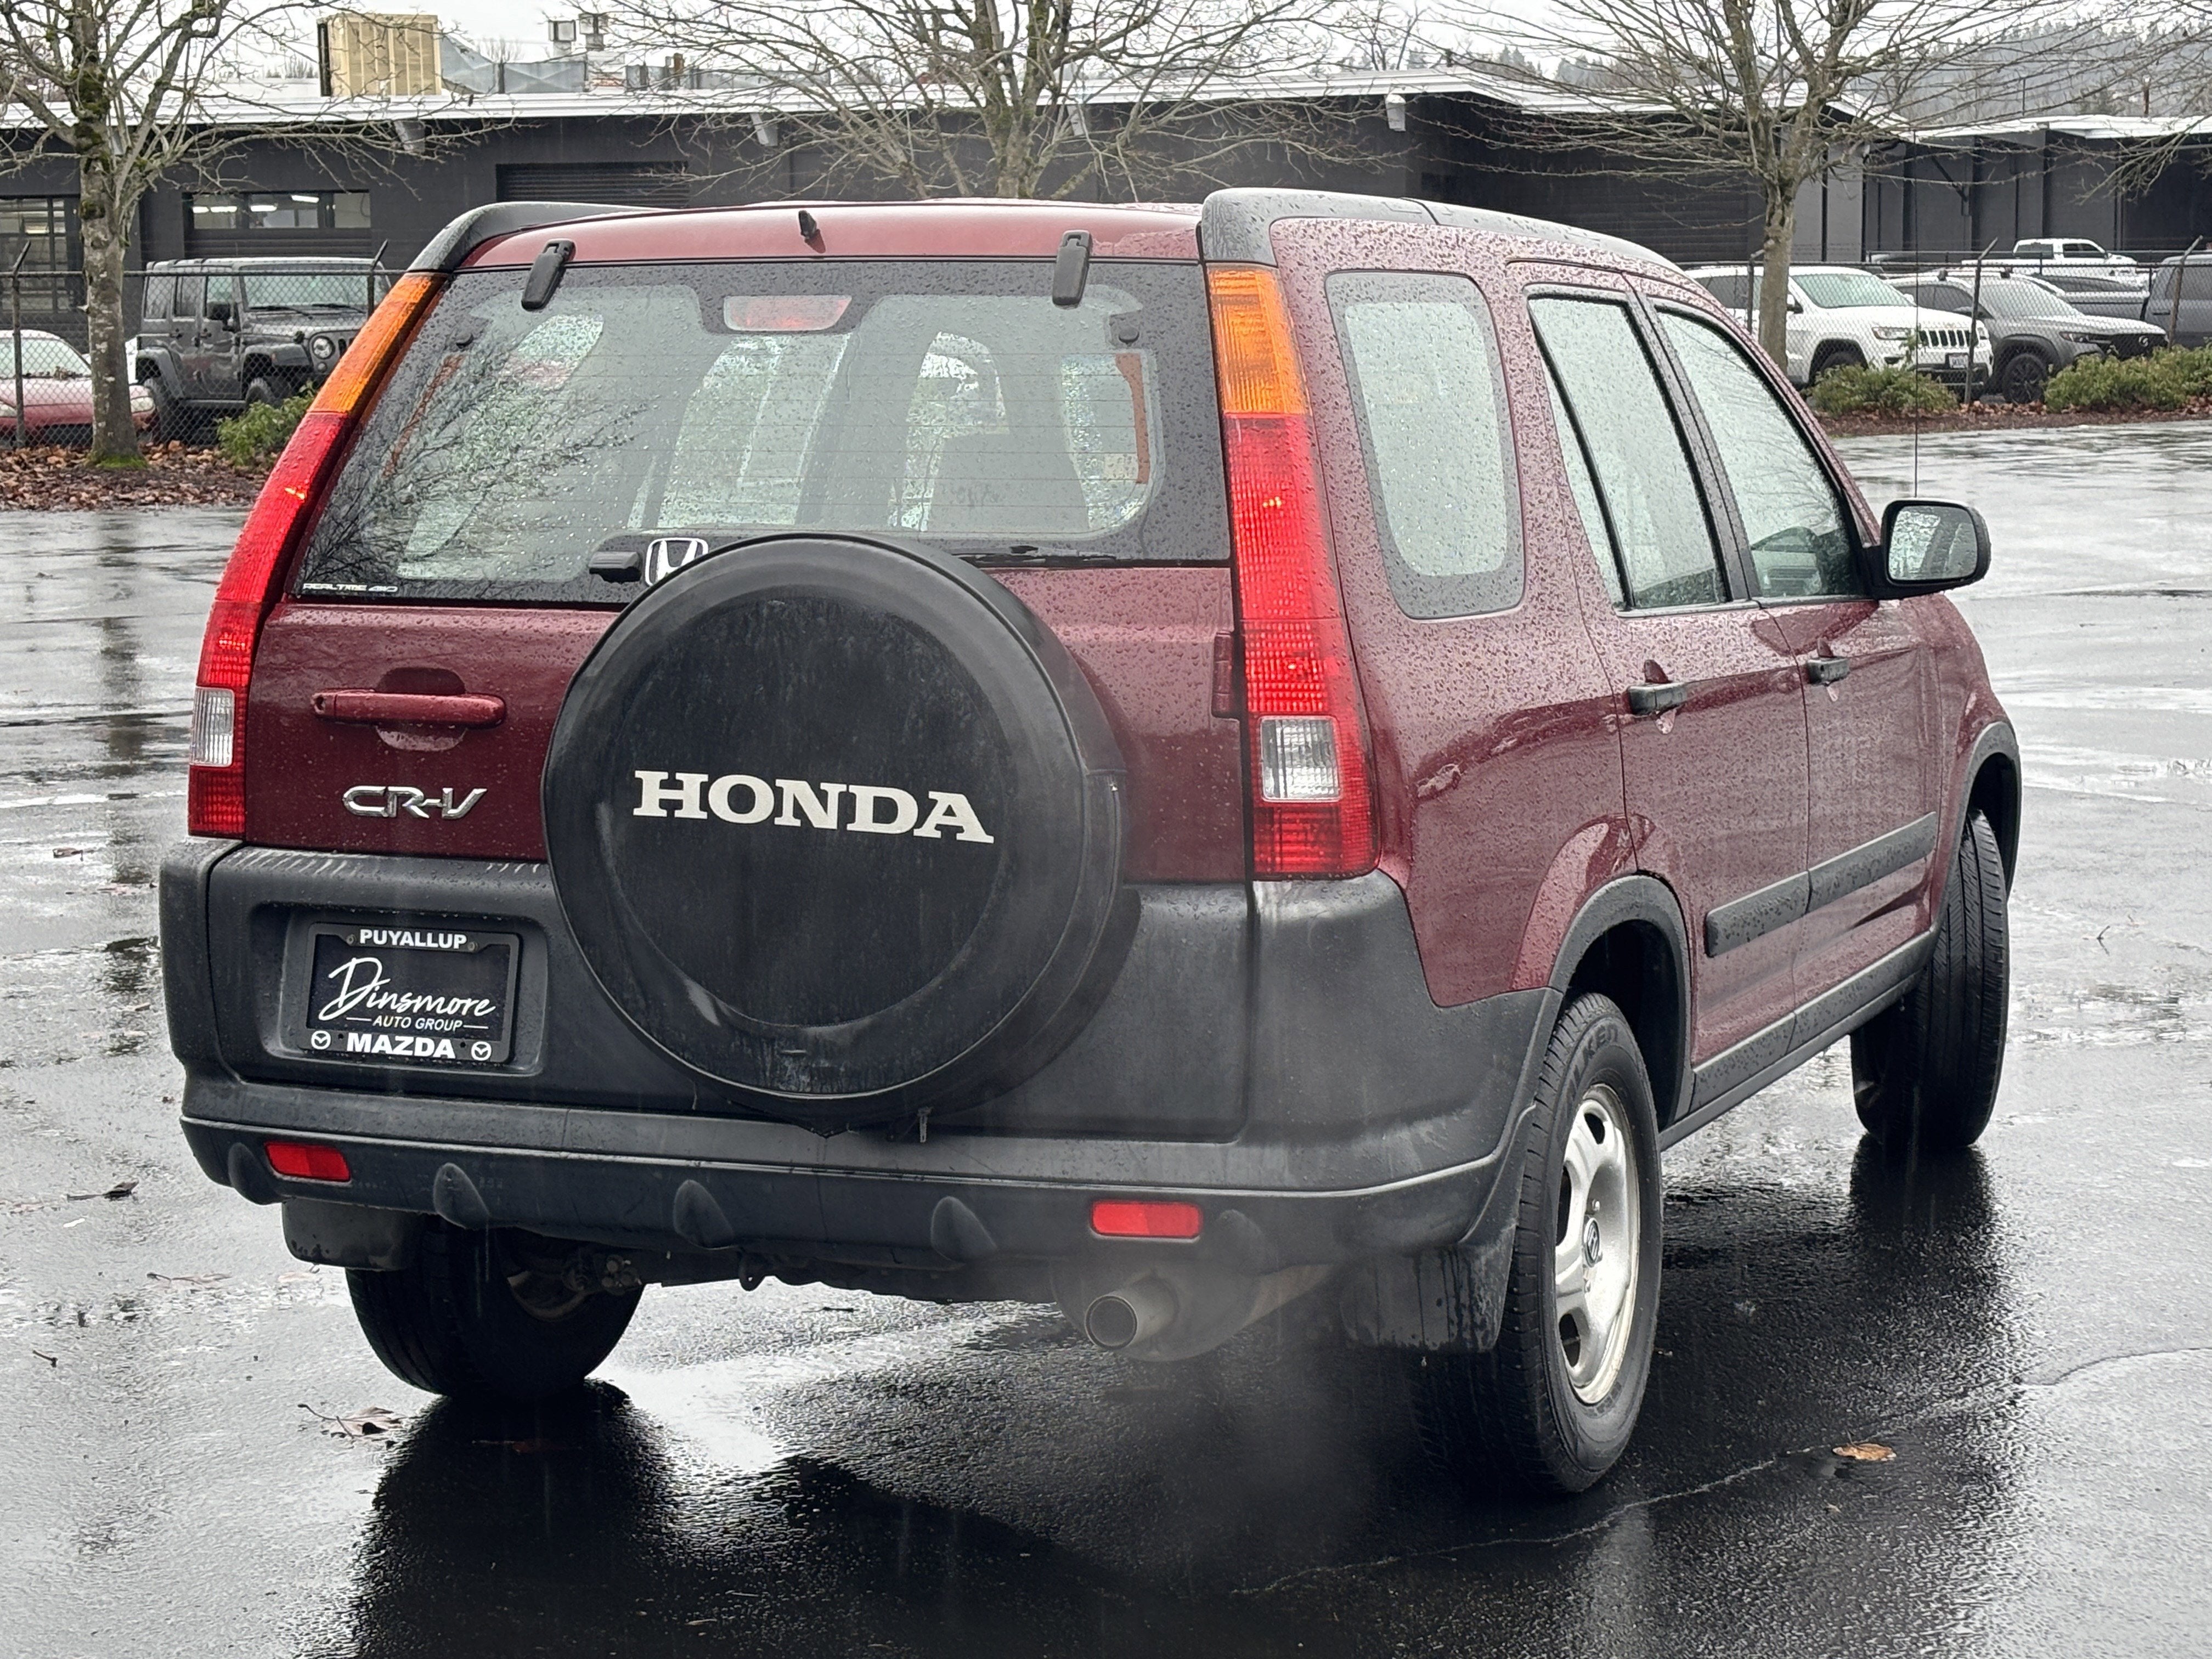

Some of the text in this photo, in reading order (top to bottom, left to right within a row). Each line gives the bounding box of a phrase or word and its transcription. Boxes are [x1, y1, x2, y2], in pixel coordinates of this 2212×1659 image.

[342, 785, 488, 820] CR-V
[633, 770, 995, 844] HONDA
[359, 929, 467, 949] PUYALLUP
[318, 957, 496, 1021] Dinsmore
[372, 1017, 464, 1031] AUTO GROUP
[346, 1032, 456, 1059] MAZDA
